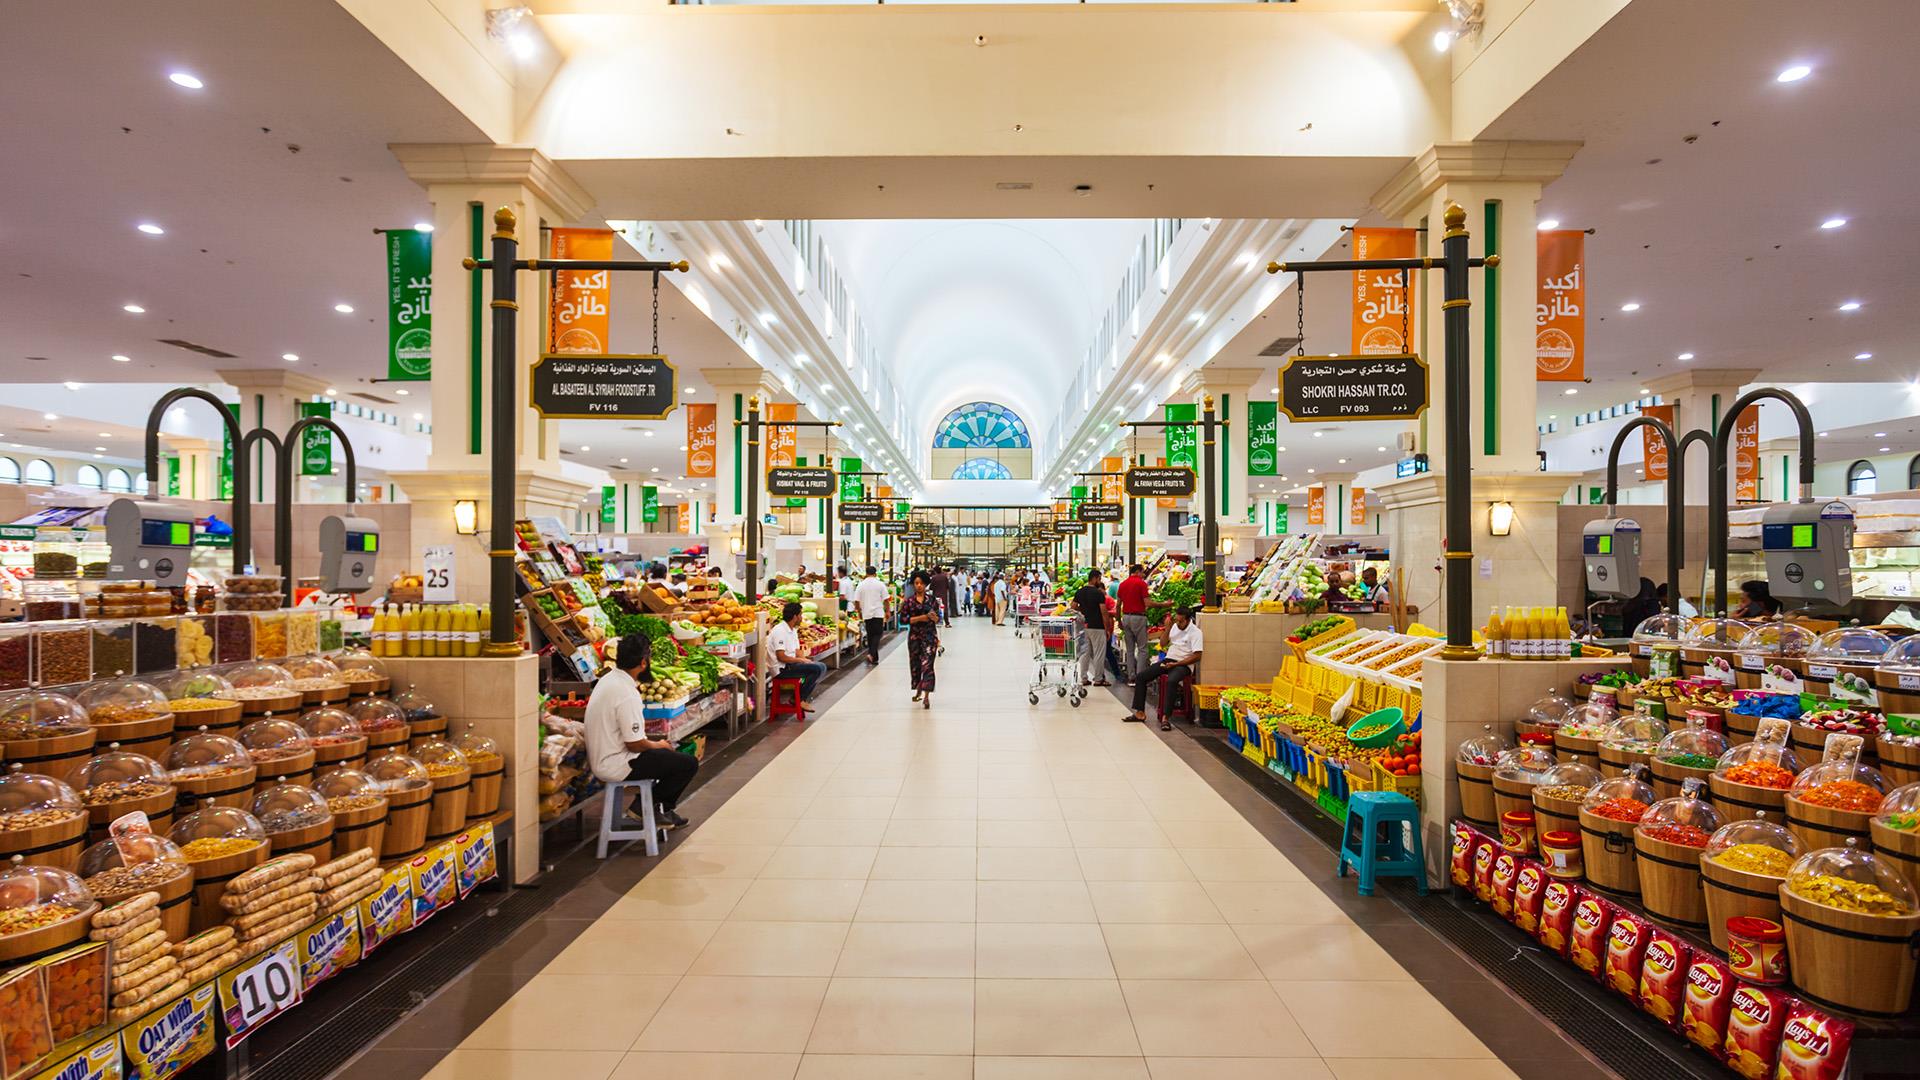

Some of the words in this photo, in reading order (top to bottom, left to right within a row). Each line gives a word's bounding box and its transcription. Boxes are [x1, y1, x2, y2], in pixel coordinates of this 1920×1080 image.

[1543, 264, 1581, 295] أكيد
[1358, 282, 1366, 303] YES,
[559, 296, 606, 324] طازج
[1362, 295, 1409, 324] طازج
[1536, 296, 1579, 325] طازج
[552, 363, 576, 374] الغذائية
[577, 363, 590, 374] المواد
[591, 363, 608, 374] لتجارة
[610, 363, 632, 376] السورية
[632, 364, 656, 376] البساتين
[1302, 366, 1335, 377] التجارية
[1338, 367, 1356, 376] حسن
[1359, 364, 1382, 376] شكري
[1385, 363, 1407, 374] شركة
[552, 383, 559, 395] AL
[560, 383, 587, 396] BASATEEN
[588, 384, 594, 396] AL
[595, 384, 614, 396] SYRIAH
[615, 384, 646, 396] FOODSTUFF
[1302, 385, 1336, 398] SHOKRI
[1338, 385, 1375, 398] HASSAN
[1377, 383, 1407, 396] TR.CO.
[697, 420, 715, 435] أكيد
[1256, 418, 1275, 433] أكيد
[1737, 421, 1756, 436] أكيد
[692, 436, 715, 450] طازج
[1172, 437, 1195, 451] طازج
[1251, 434, 1275, 448] طازج
[427, 569, 449, 588] 25
[1545, 886, 1557, 900] Lay's
[1577, 905, 1591, 920] Lay's
[308, 929, 326, 955] OAT
[326, 914, 344, 939] With
[1611, 923, 1626, 938] Lay's
[1647, 944, 1664, 959] Lay's
[1689, 967, 1707, 986] Lay's
[242, 962, 290, 1018] 10
[1703, 980, 1720, 994] ليز
[1733, 991, 1754, 1010] Lay's
[1750, 1005, 1769, 1022] ليز
[139, 1019, 165, 1054] OAT
[167, 998, 193, 1030] With
[1786, 1020, 1810, 1042] Lay's
[1803, 1037, 1829, 1054] ليز
